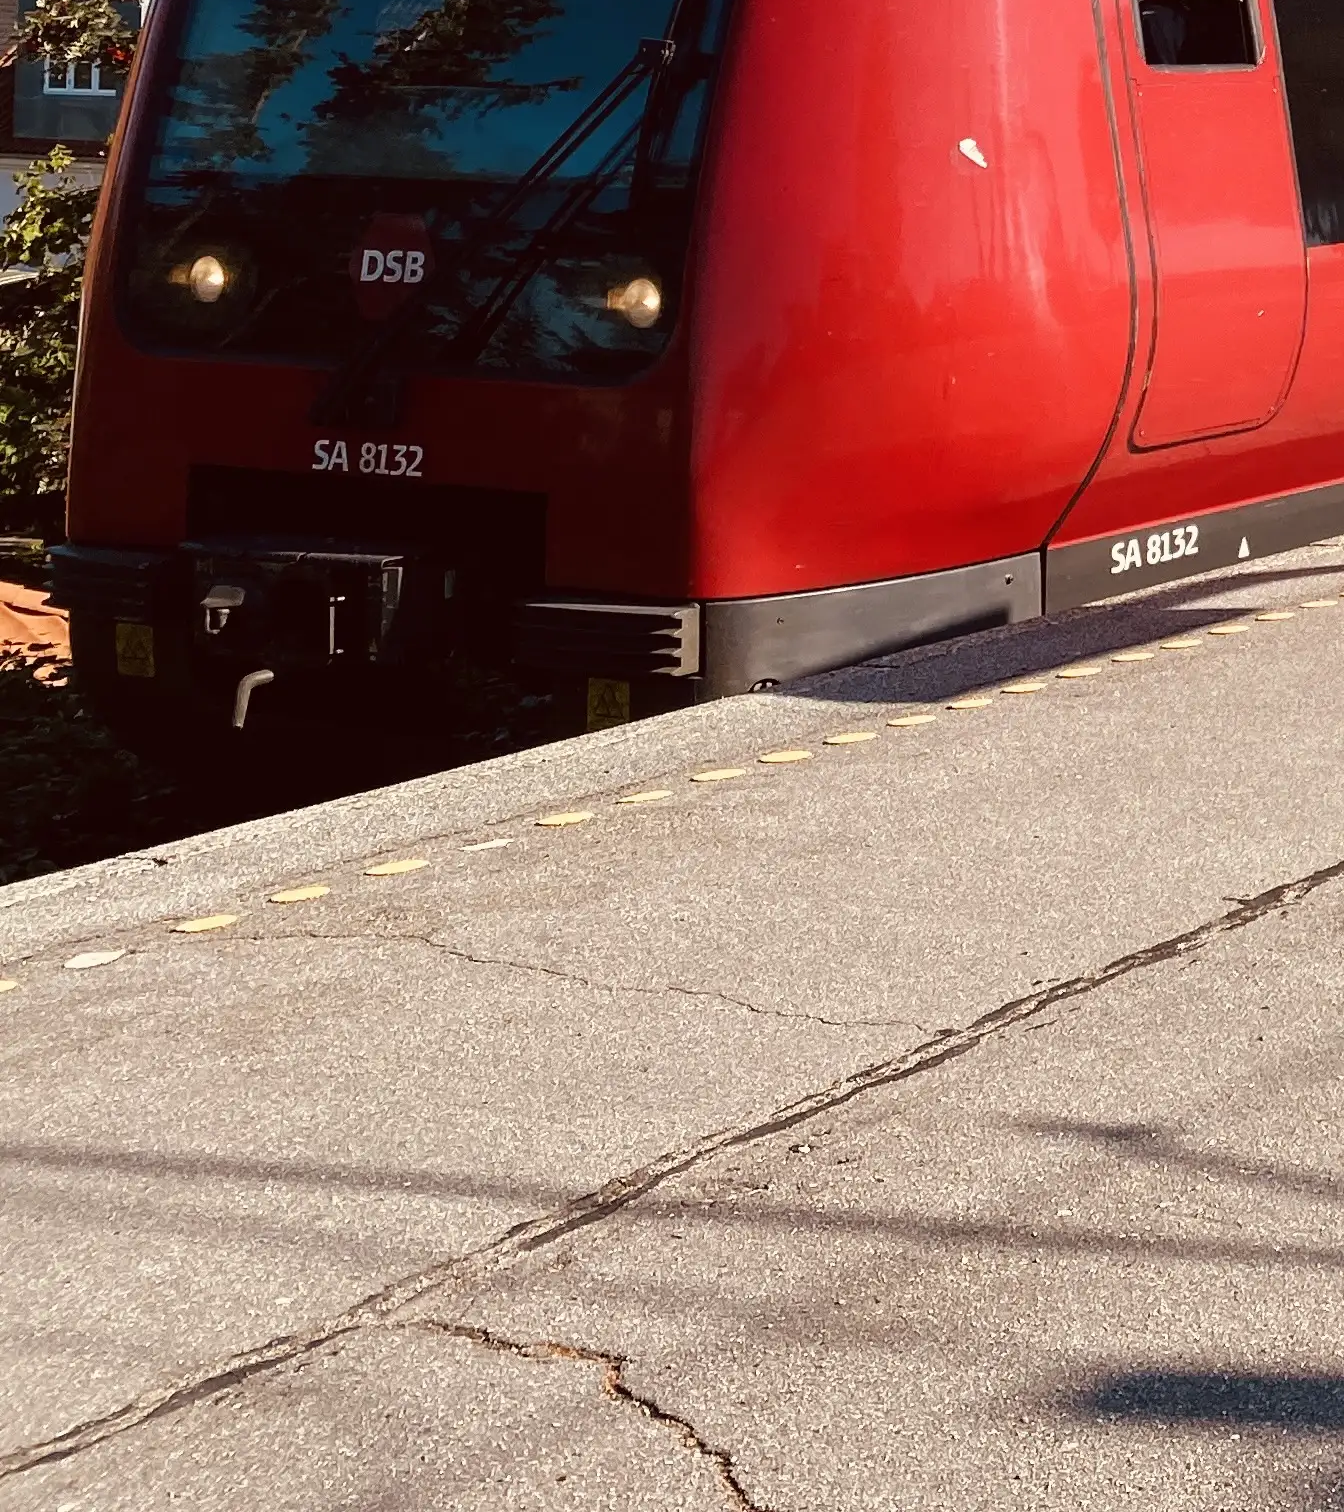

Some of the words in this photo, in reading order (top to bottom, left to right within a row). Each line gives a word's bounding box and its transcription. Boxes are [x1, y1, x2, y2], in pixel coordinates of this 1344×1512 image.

[360, 249, 425, 284] DSB
[311, 440, 348, 472] SA
[358, 444, 423, 477] 8132
[1110, 537, 1142, 574] SA
[1146, 525, 1199, 565] 8132
